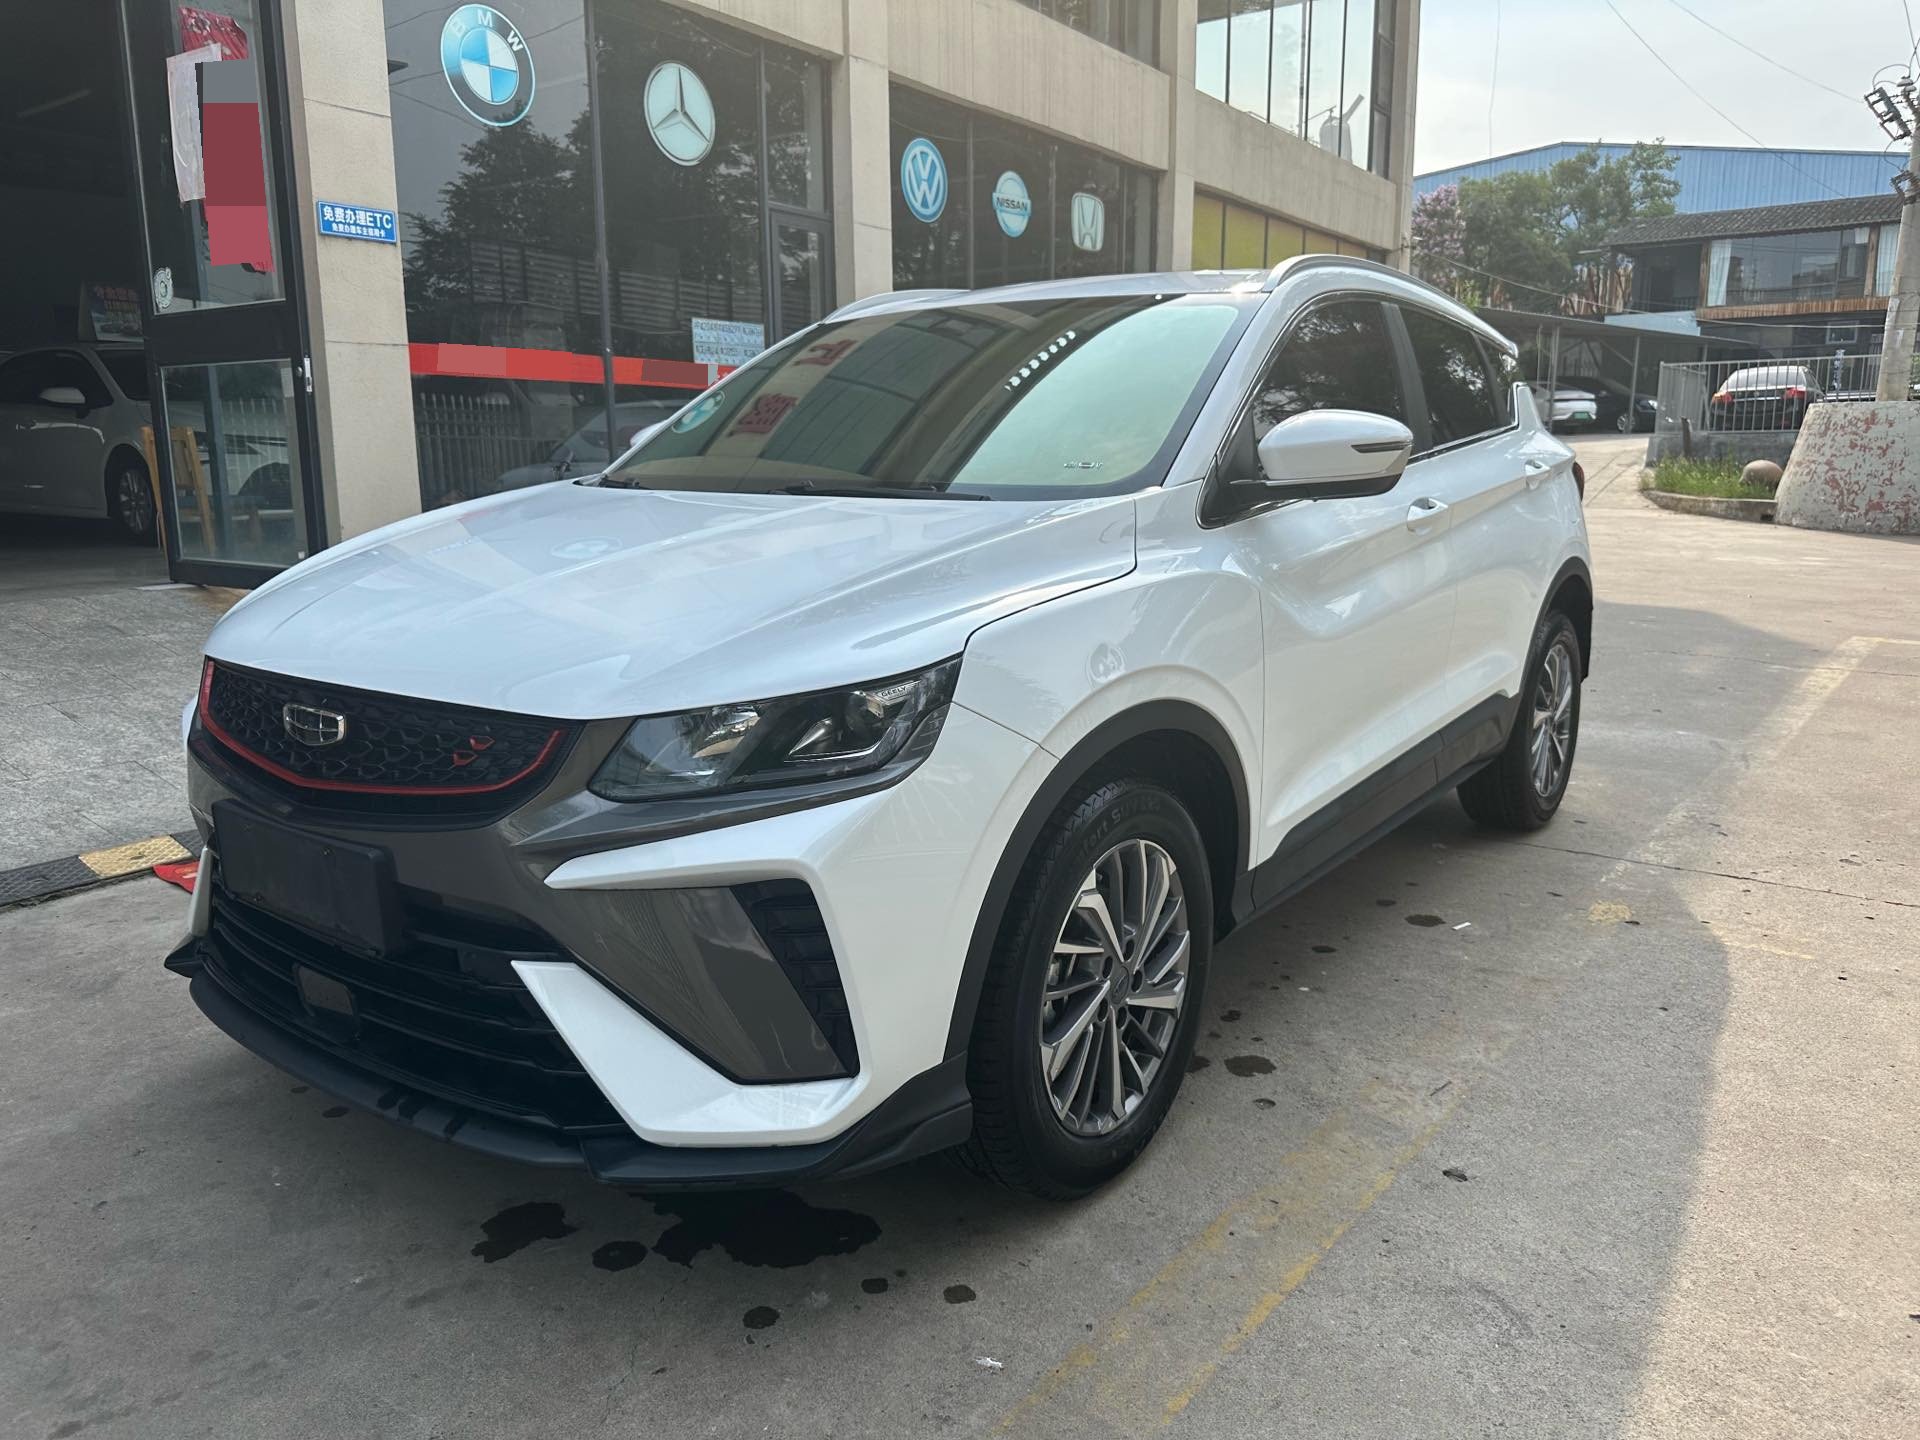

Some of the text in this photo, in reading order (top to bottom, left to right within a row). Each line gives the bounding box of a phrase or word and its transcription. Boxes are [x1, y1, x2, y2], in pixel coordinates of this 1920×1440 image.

[448, 9, 524, 52] BMW
[996, 196, 1029, 211] NISSAN
[323, 205, 392, 229] 免费办理ETC
[881, 685, 906, 697] GEELY
